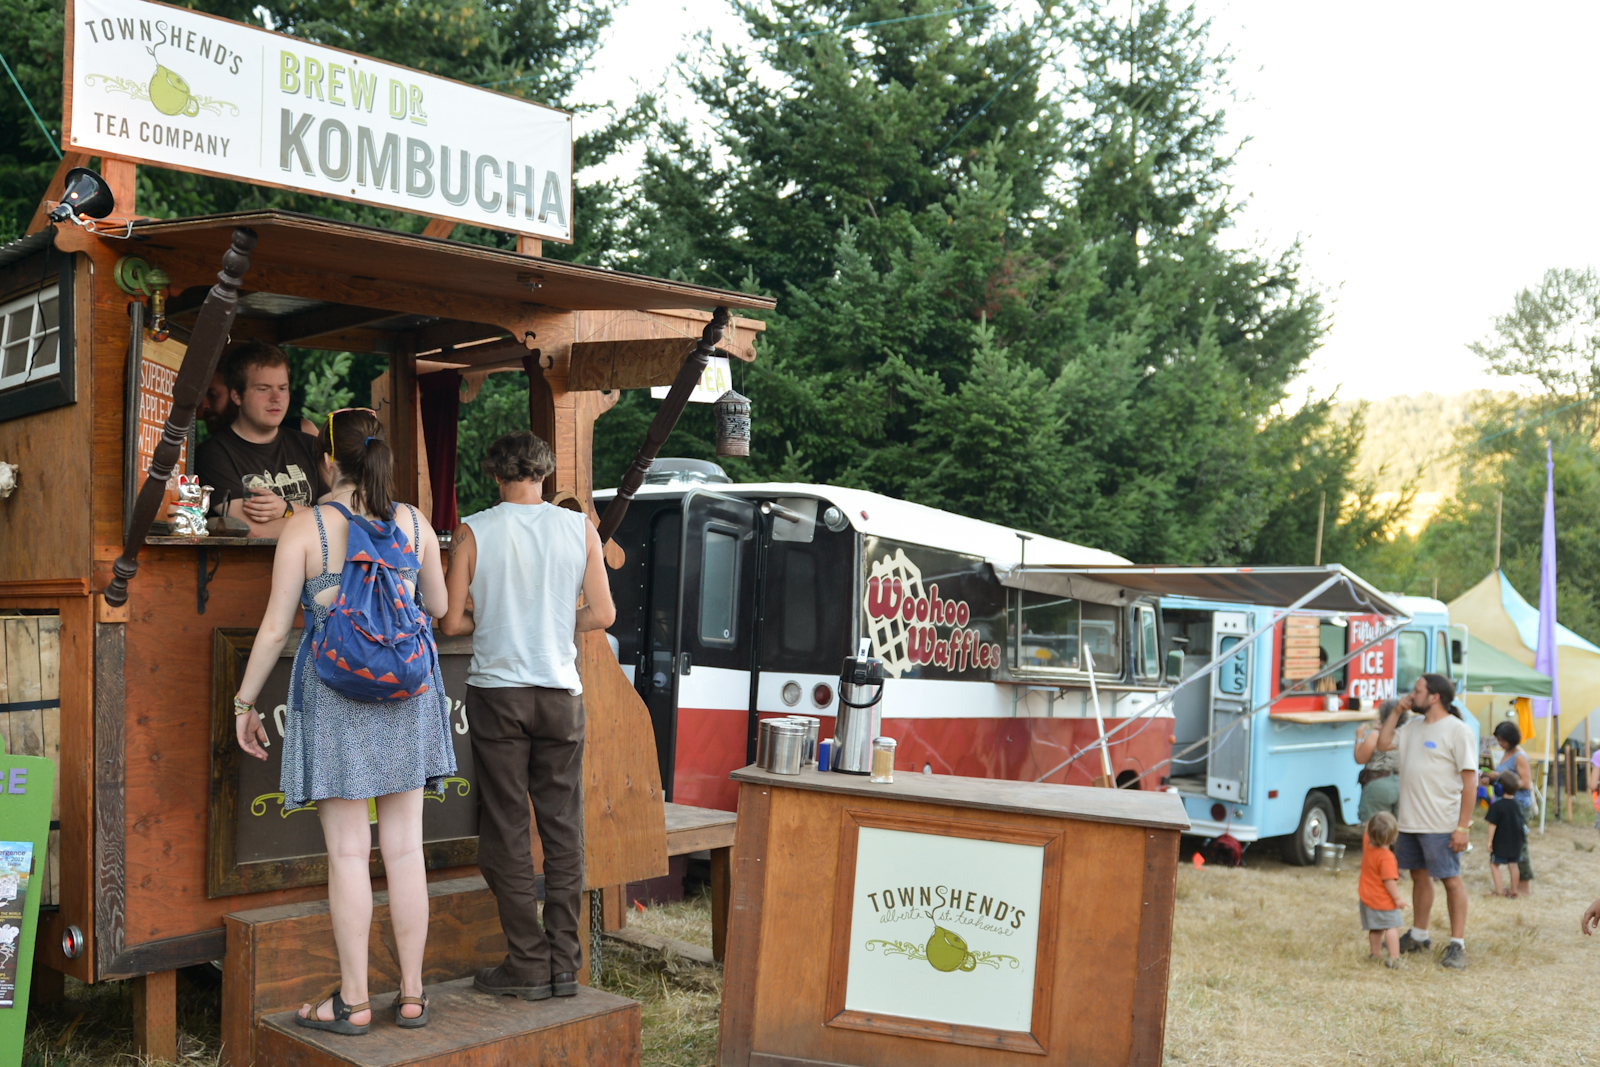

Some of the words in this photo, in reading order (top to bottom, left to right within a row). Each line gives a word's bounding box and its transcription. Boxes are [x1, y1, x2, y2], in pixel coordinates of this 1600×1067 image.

[85, 17, 243, 75] TOWNSHEND'S
[280, 50, 377, 113] BREW
[94, 112, 130, 139] TEA
[139, 121, 230, 157] COMPANY
[280, 107, 567, 228] KOMBUCHA
[140, 359, 178, 397] SUPERBE
[699, 366, 727, 392] EA
[867, 575, 970, 628] Woohoo
[905, 625, 1001, 673] Waffles
[1360, 651, 1384, 675] ICE
[1349, 678, 1394, 701] CREAM
[867, 885, 1026, 929] TOWNSHEND'S
[880, 906, 924, 924] alberta
[938, 910, 952, 921] st.
[954, 911, 1014, 937] teahouse
